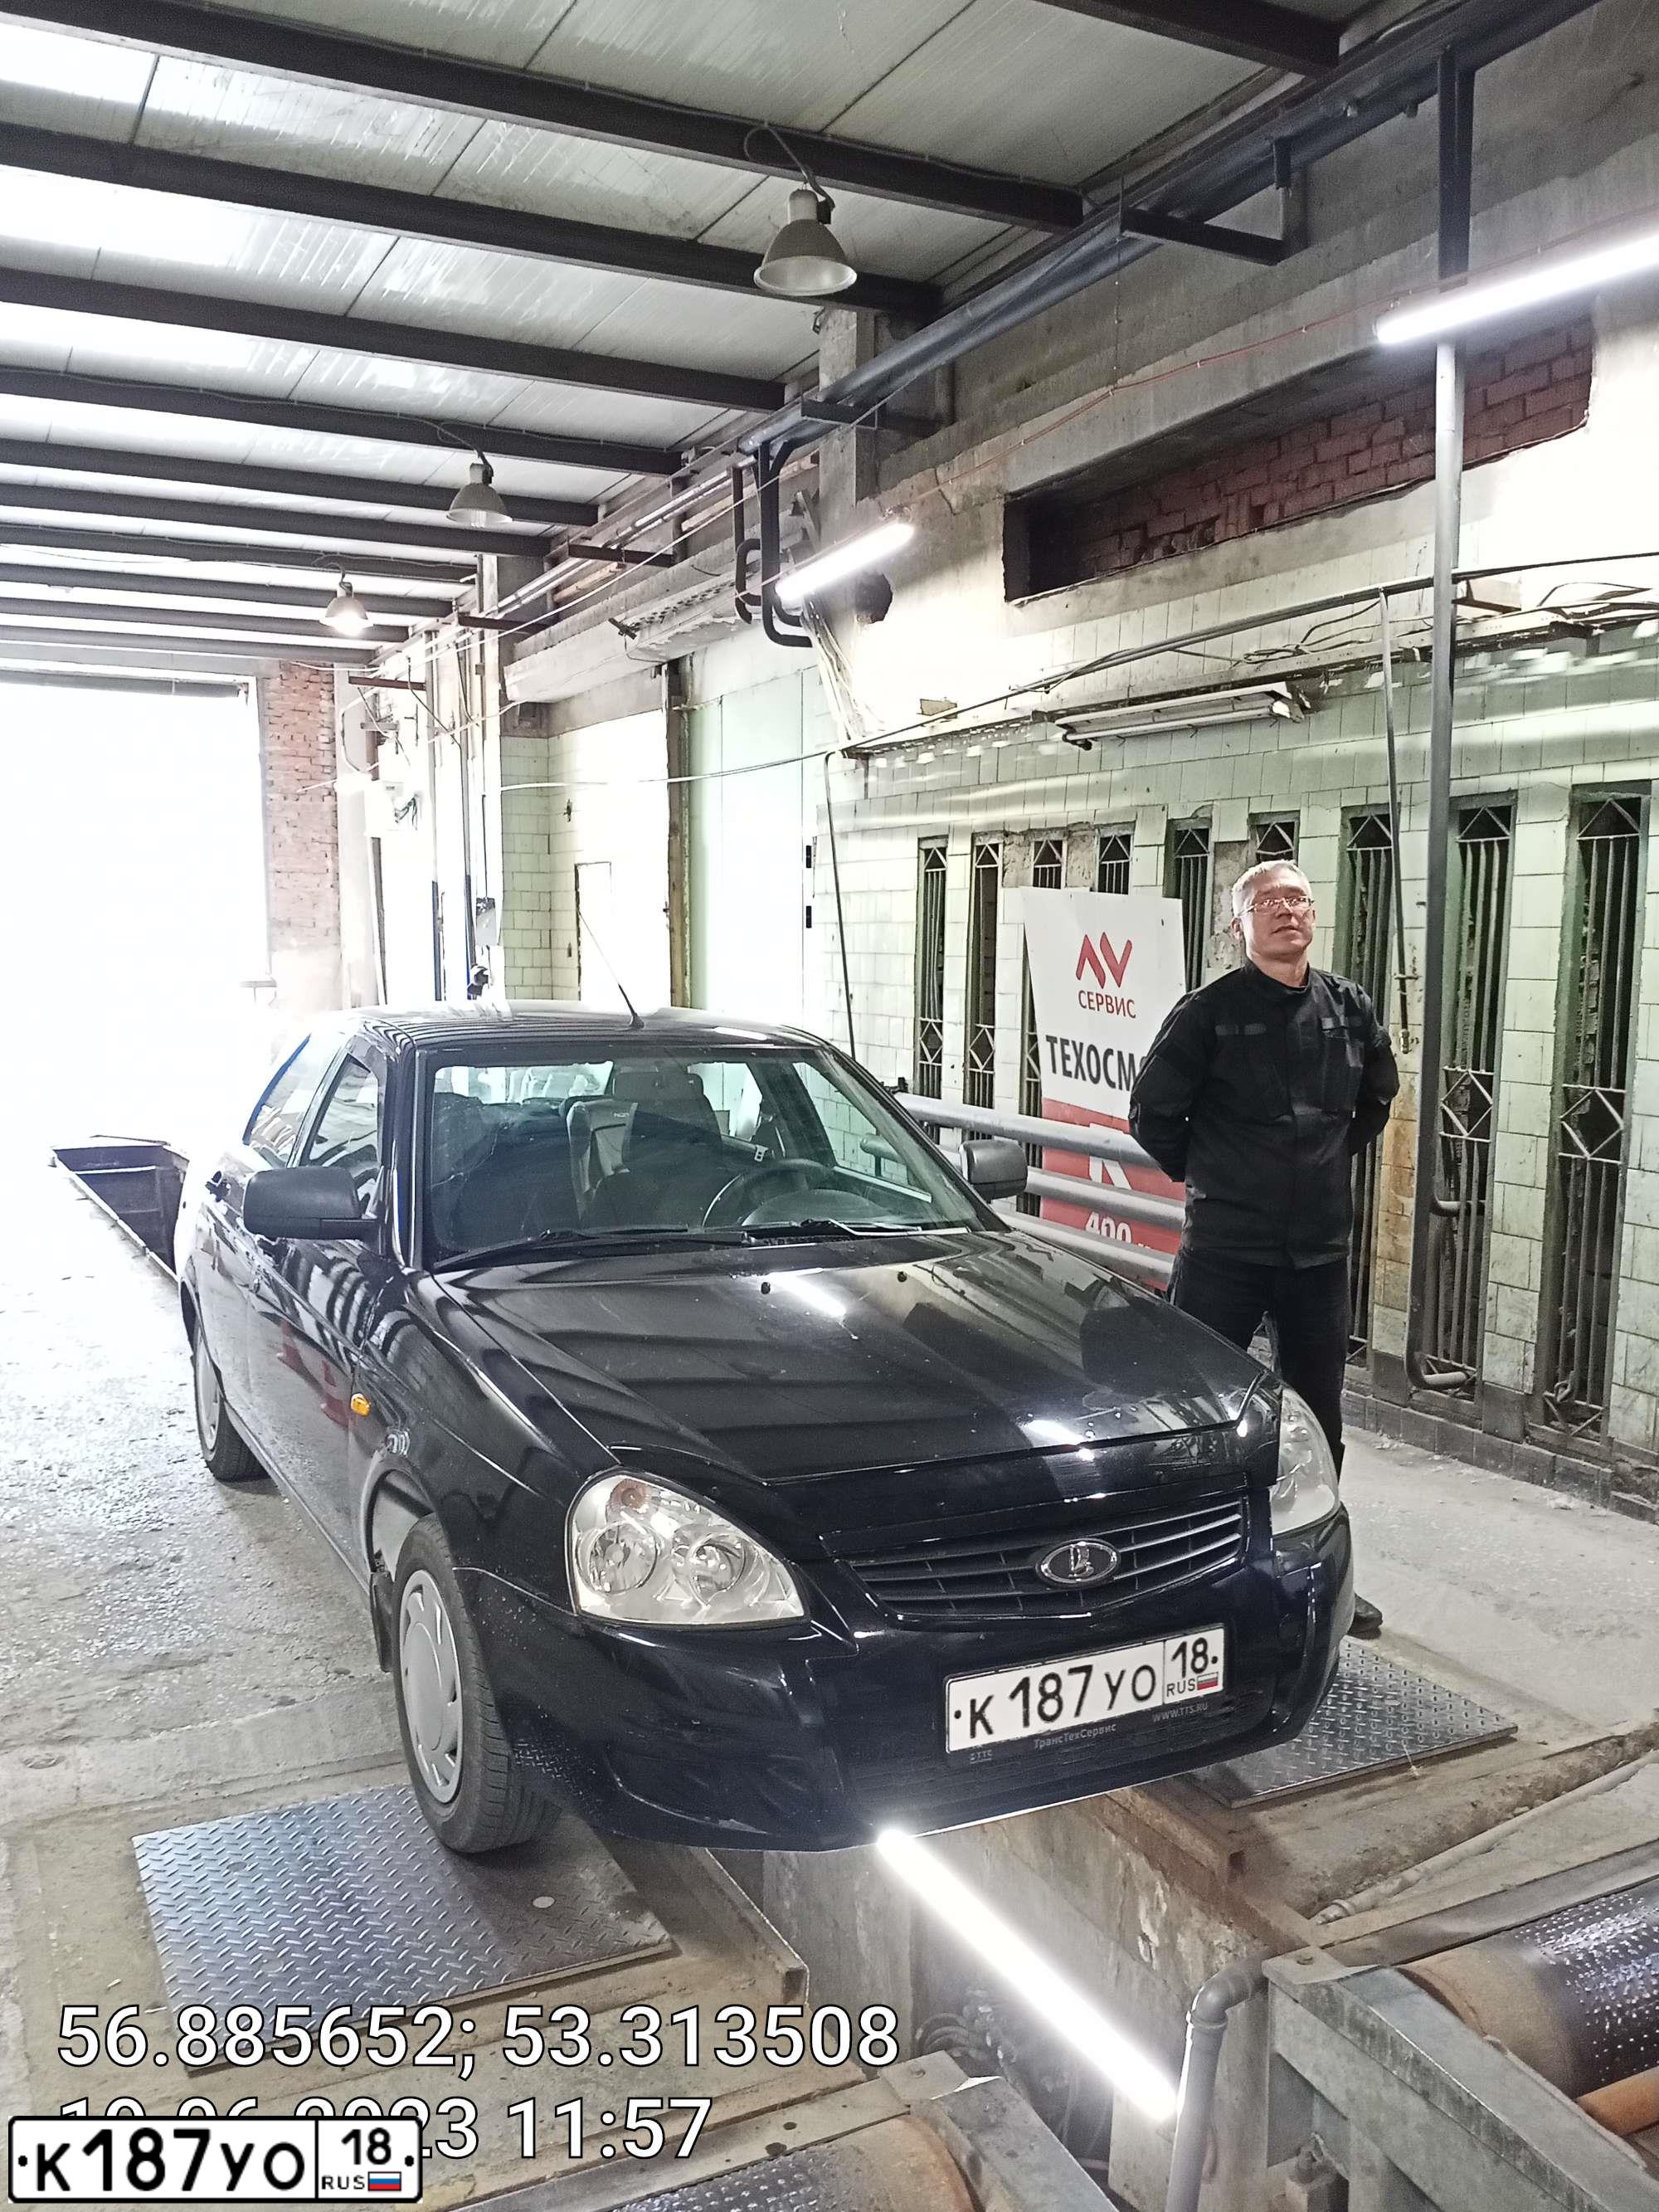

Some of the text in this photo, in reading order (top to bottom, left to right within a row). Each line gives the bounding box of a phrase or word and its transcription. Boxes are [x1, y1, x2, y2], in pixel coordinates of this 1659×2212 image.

[1078, 990, 1136, 1019] СЕРВИС
[1045, 1034, 1146, 1092] ТЕХОСМ
[1170, 1636, 1209, 1678] 18
[1166, 1678, 1195, 1698] RUS
[1034, 1722, 1117, 1750] ТрансТехСервис
